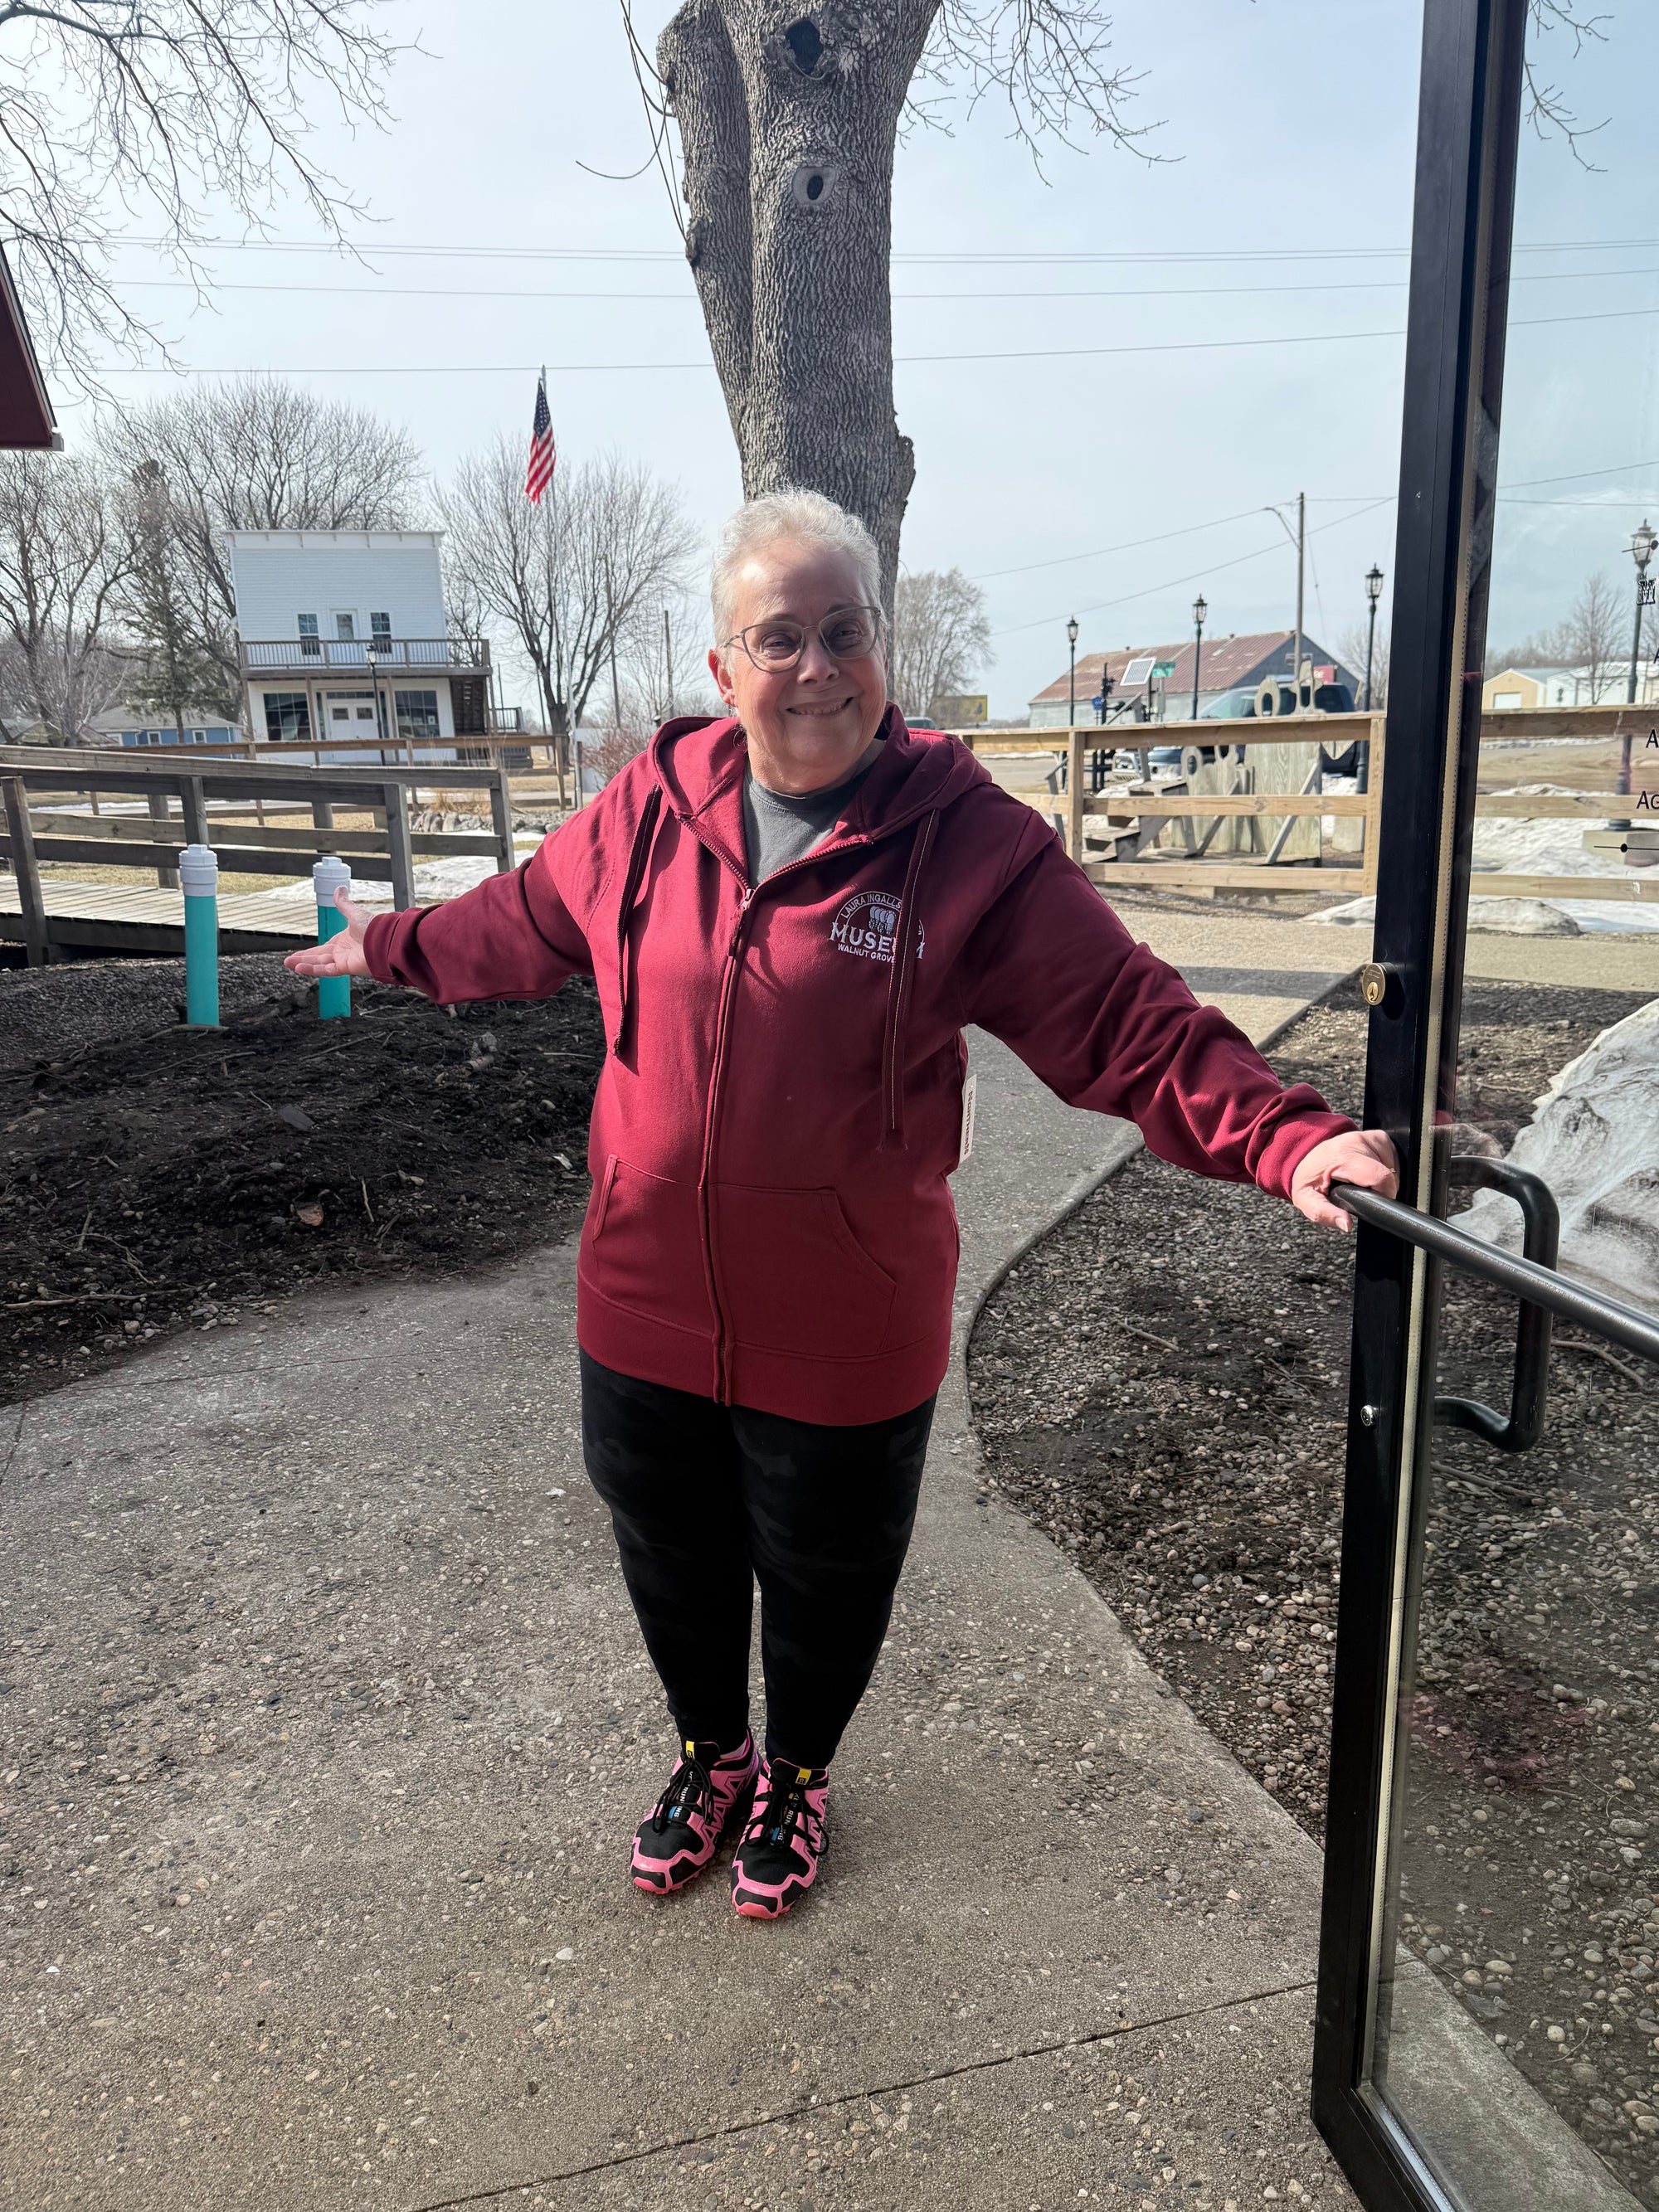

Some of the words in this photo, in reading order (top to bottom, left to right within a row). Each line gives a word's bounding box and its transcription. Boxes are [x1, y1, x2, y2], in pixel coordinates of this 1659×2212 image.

[840, 896, 867, 919] LAURA
[867, 893, 902, 909] INGALLS
[838, 943, 869, 958] WALNUT
